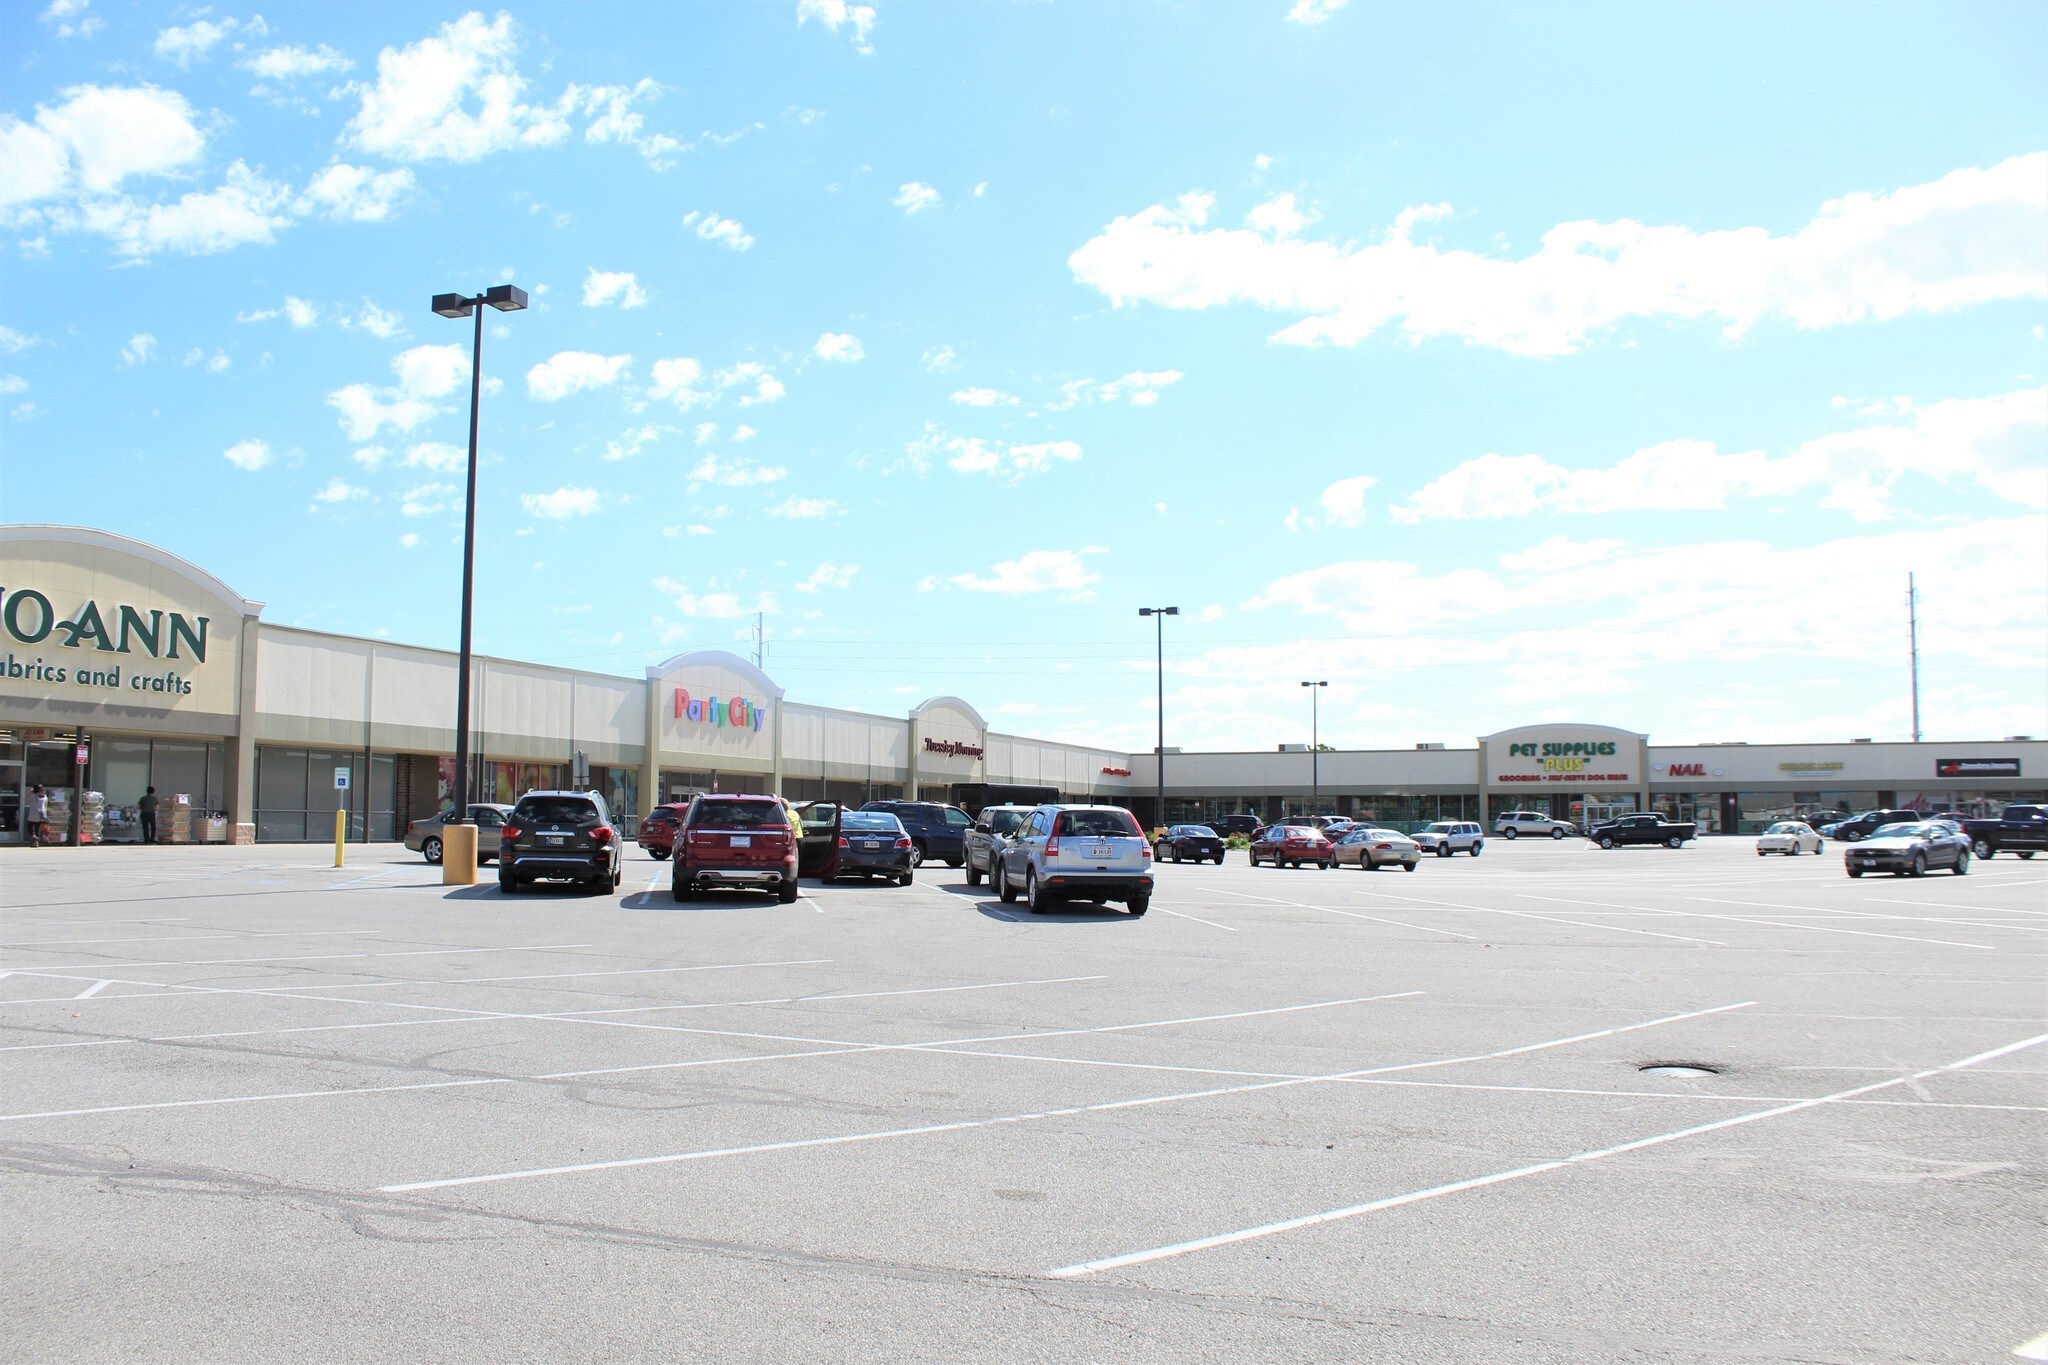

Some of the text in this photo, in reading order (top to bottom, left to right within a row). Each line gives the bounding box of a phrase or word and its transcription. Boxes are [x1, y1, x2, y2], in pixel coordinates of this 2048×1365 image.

[0, 586, 210, 664] O-ANN
[76, 665, 120, 688] and
[130, 671, 192, 695] crafts
[674, 687, 766, 733] Party City
[924, 737, 984, 761] Tuesday Morning
[1509, 742, 1616, 757] PET SUPPLIES
[1498, 774, 1541, 782] GROOMING
[1587, 773, 1606, 781] DOG
[1606, 773, 1628, 781] WASH
[1668, 763, 1707, 776] NAIL
